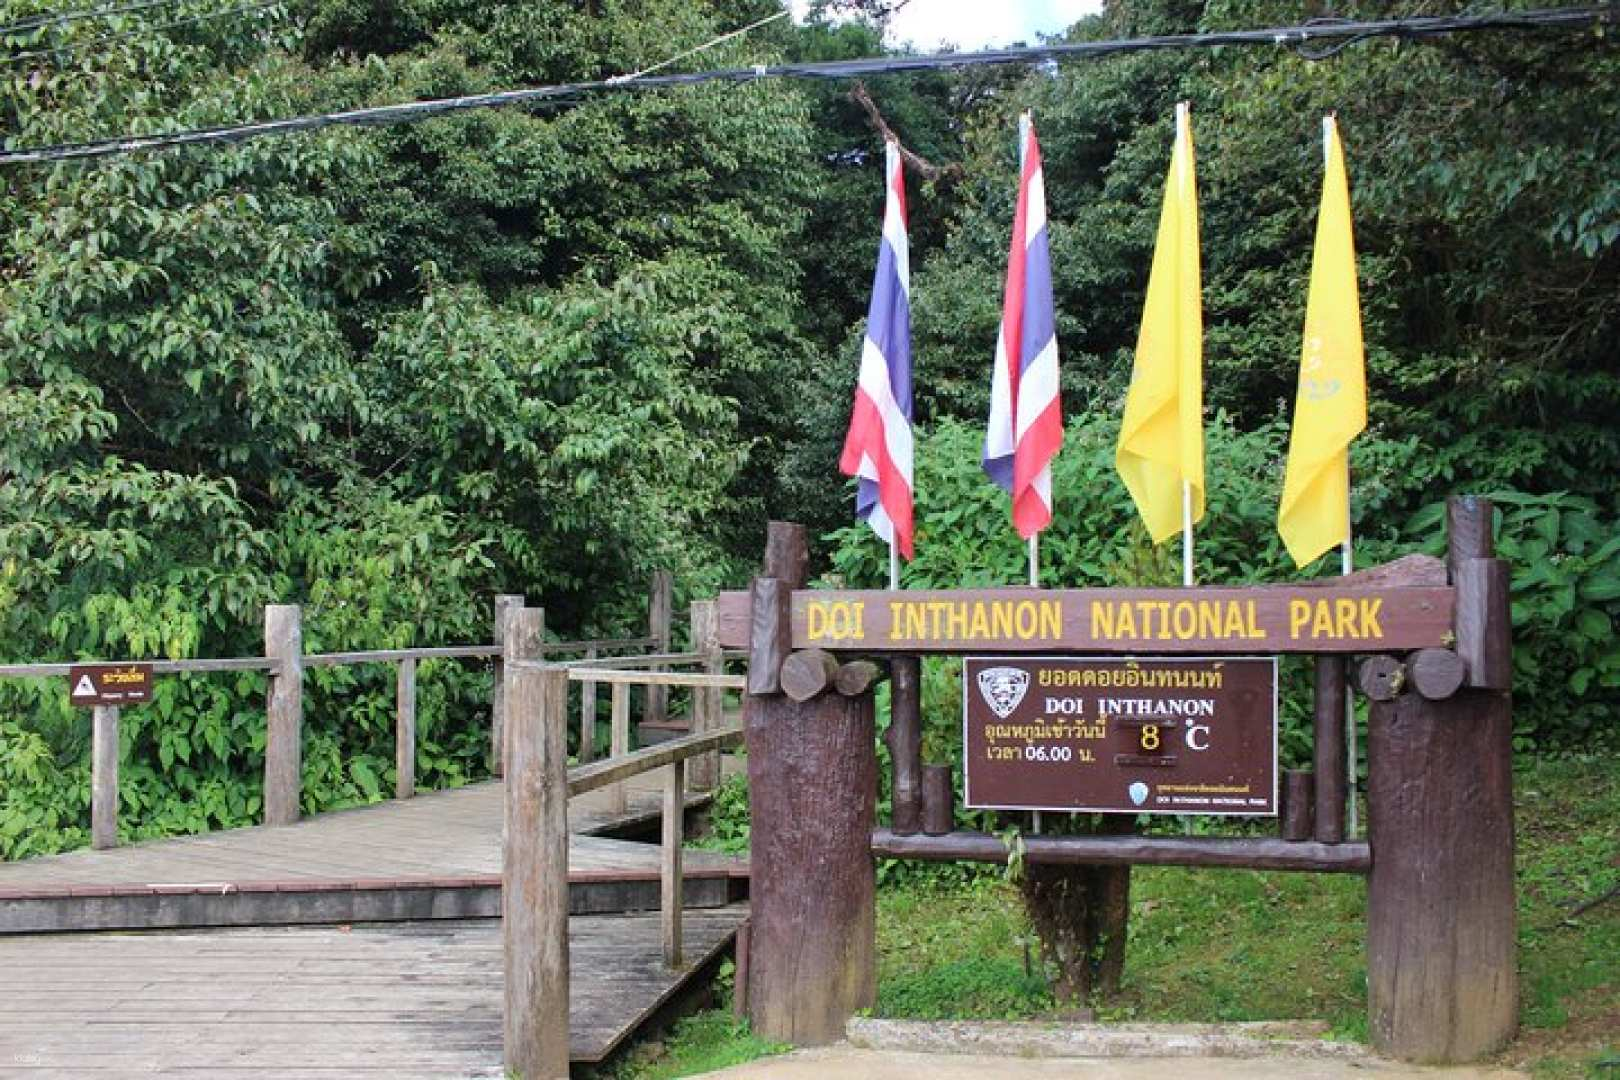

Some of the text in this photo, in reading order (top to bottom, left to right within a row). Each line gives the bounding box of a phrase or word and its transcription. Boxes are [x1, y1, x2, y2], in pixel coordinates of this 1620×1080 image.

[807, 598, 1384, 640] DOI INTHANON NATIONAL PARK
[1045, 697, 1214, 716] DOI INTHANON
[1141, 724, 1160, 750] 8
[987, 747, 1022, 760] เวลา
[1025, 746, 1072, 761] 06.00
